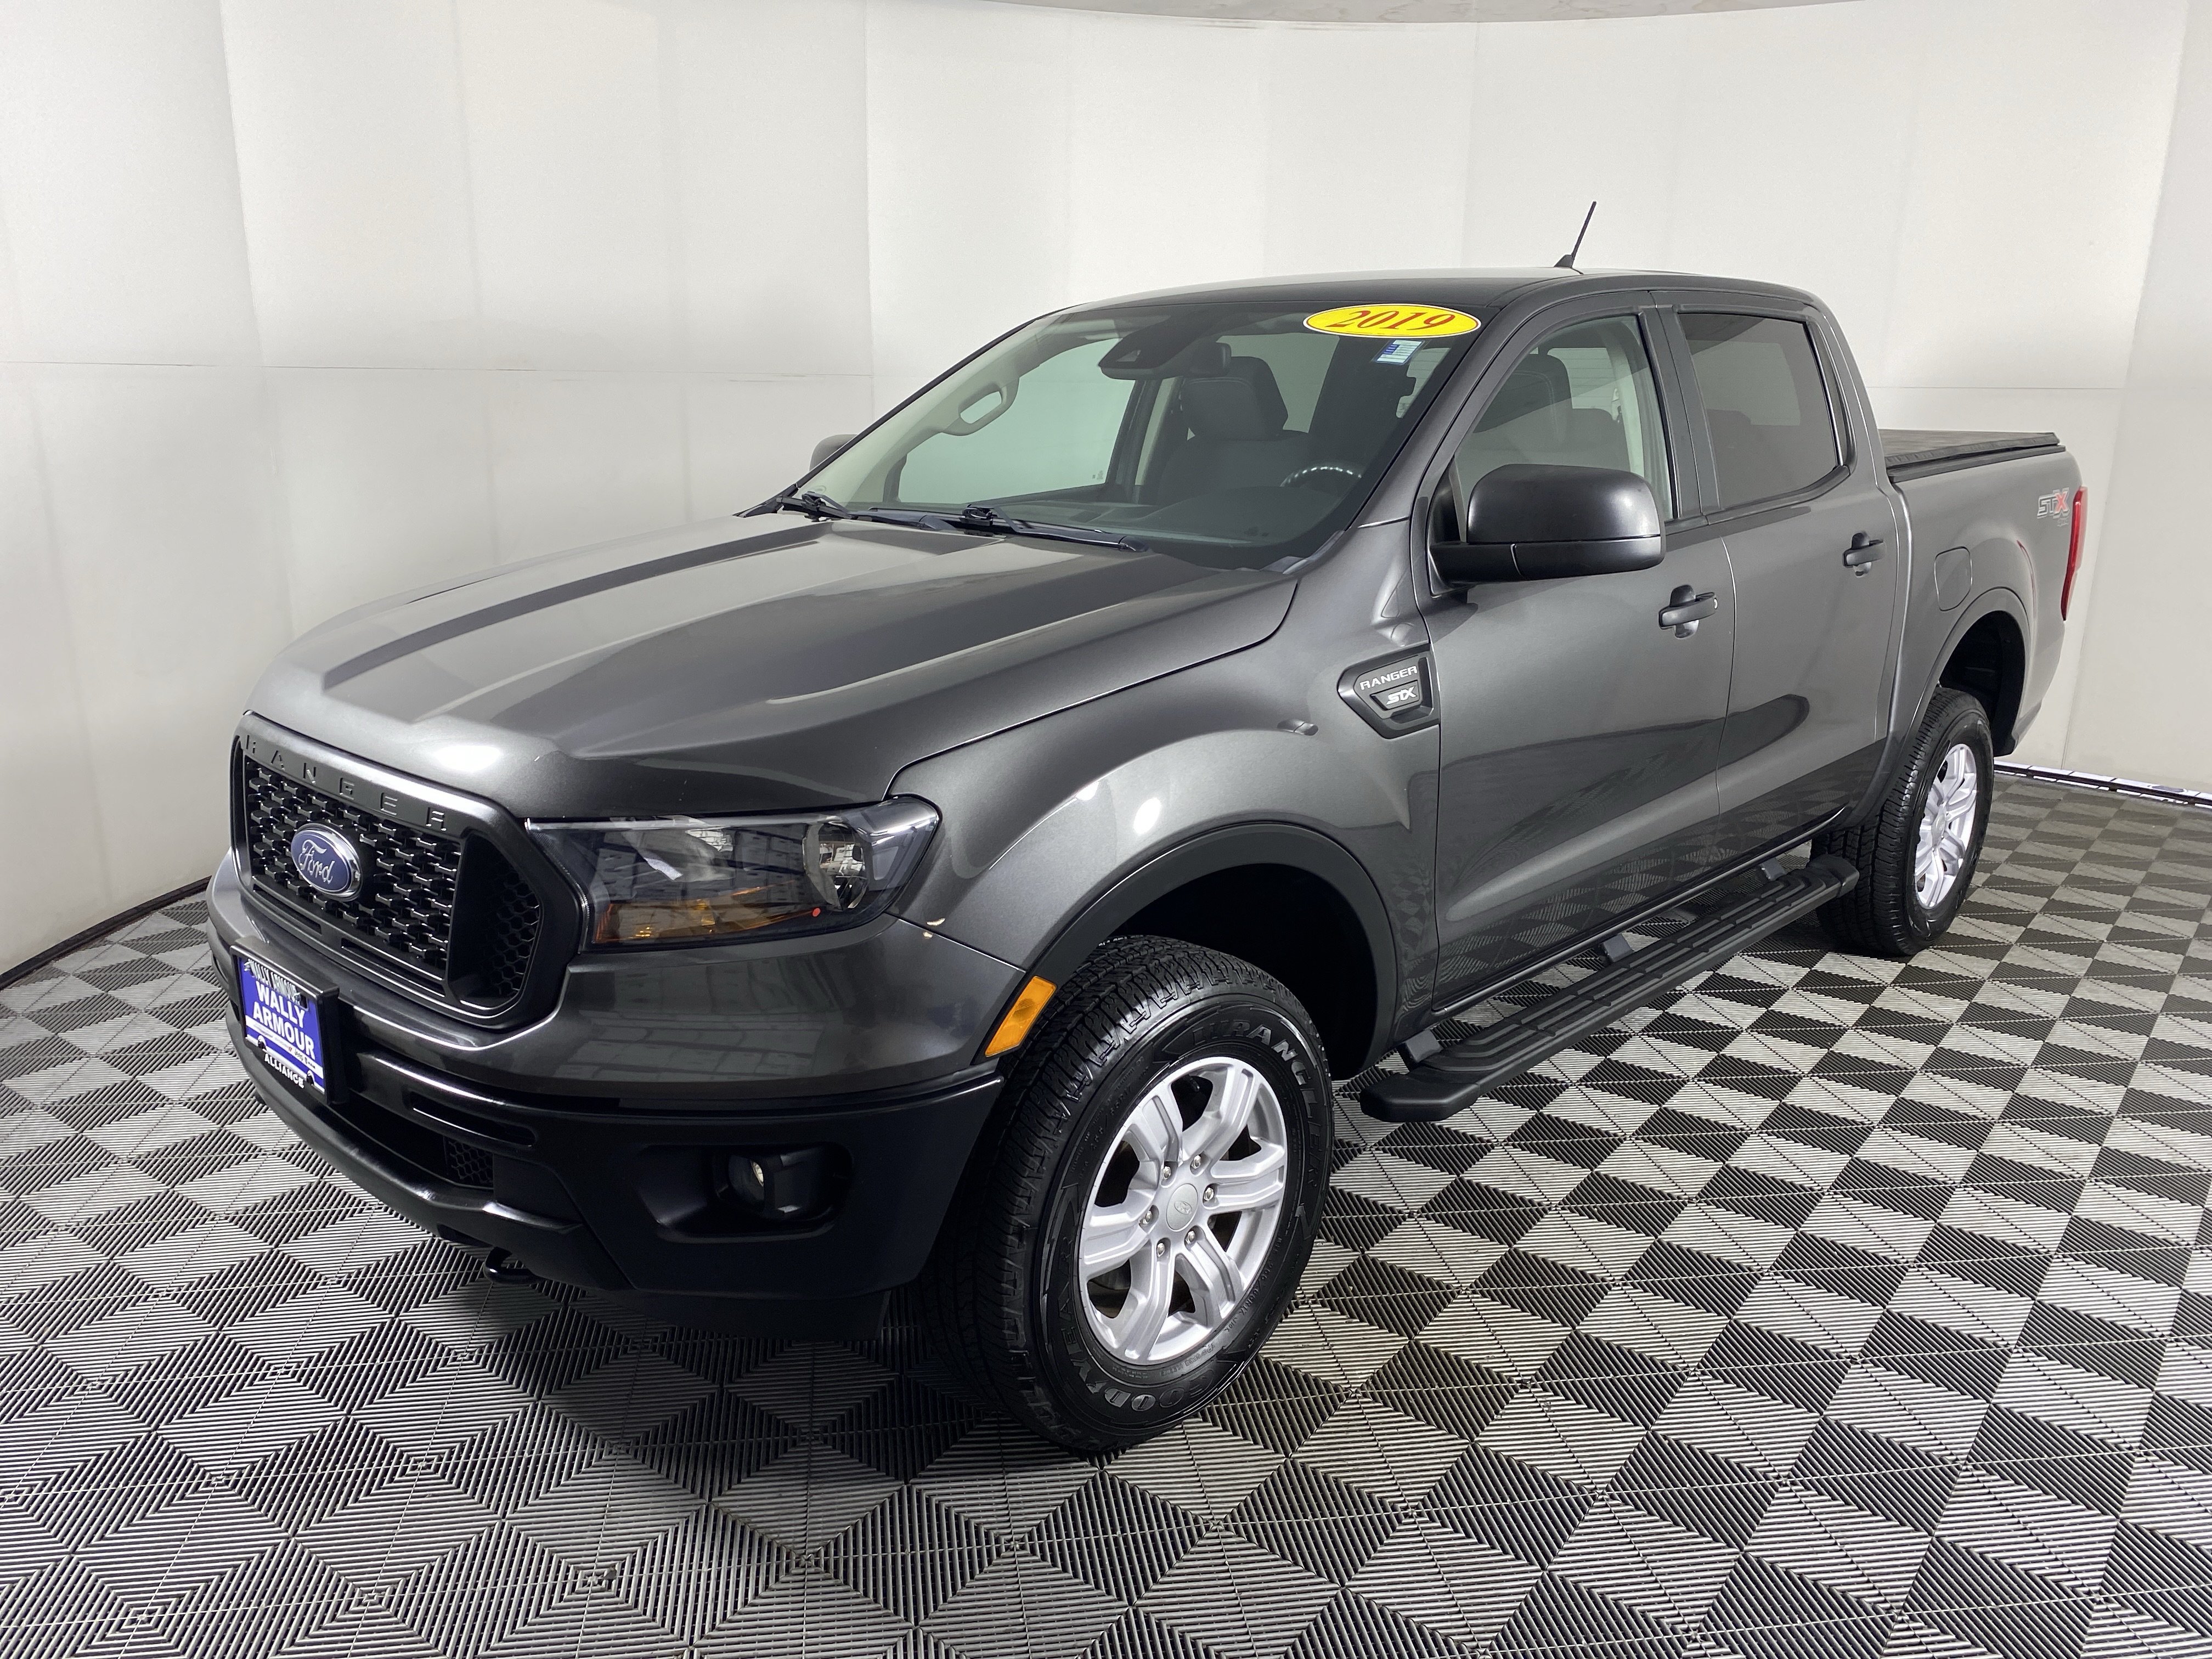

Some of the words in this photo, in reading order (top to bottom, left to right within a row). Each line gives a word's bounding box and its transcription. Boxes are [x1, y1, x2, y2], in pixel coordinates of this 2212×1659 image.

[1325, 310, 1455, 330] 2019
[2037, 487, 2070, 518] STX
[1359, 665, 1418, 690] RANGER
[1386, 686, 1417, 705] STX
[245, 735, 447, 832] RANGER
[299, 839, 336, 884] Ford
[256, 980, 305, 1029] WALLY
[253, 1002, 315, 1060] ARMOUR
[264, 1053, 304, 1088] ALLIANCE
